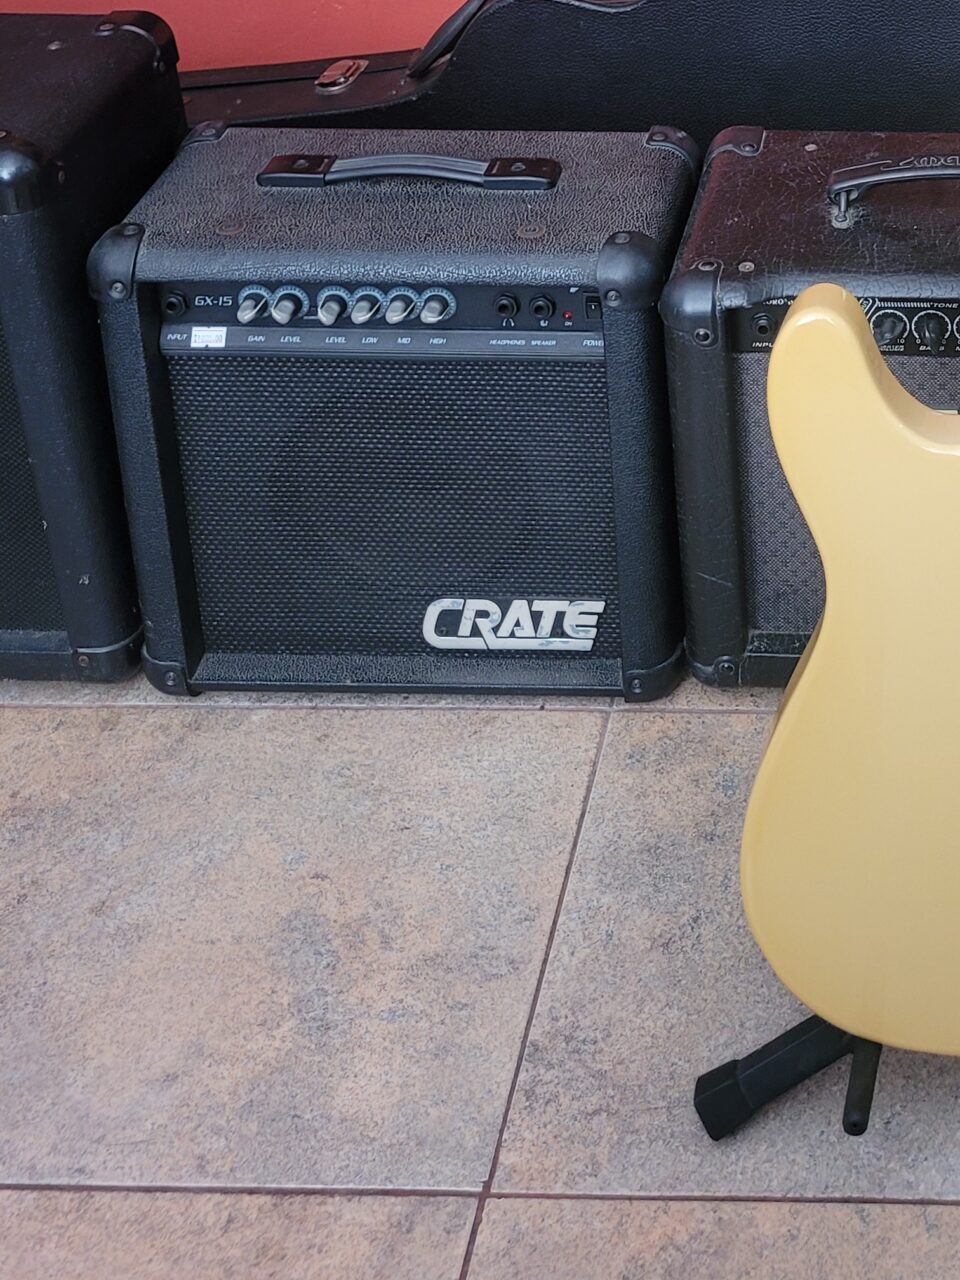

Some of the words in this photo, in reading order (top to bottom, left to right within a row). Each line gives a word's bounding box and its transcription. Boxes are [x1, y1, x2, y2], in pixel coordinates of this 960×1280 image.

[194, 295, 233, 306] GX-15
[280, 335, 301, 343] LEVEL
[361, 336, 379, 344] LOW
[429, 337, 447, 345] HIGH
[582, 339, 605, 347] POWE
[422, 598, 606, 651] CRATE
